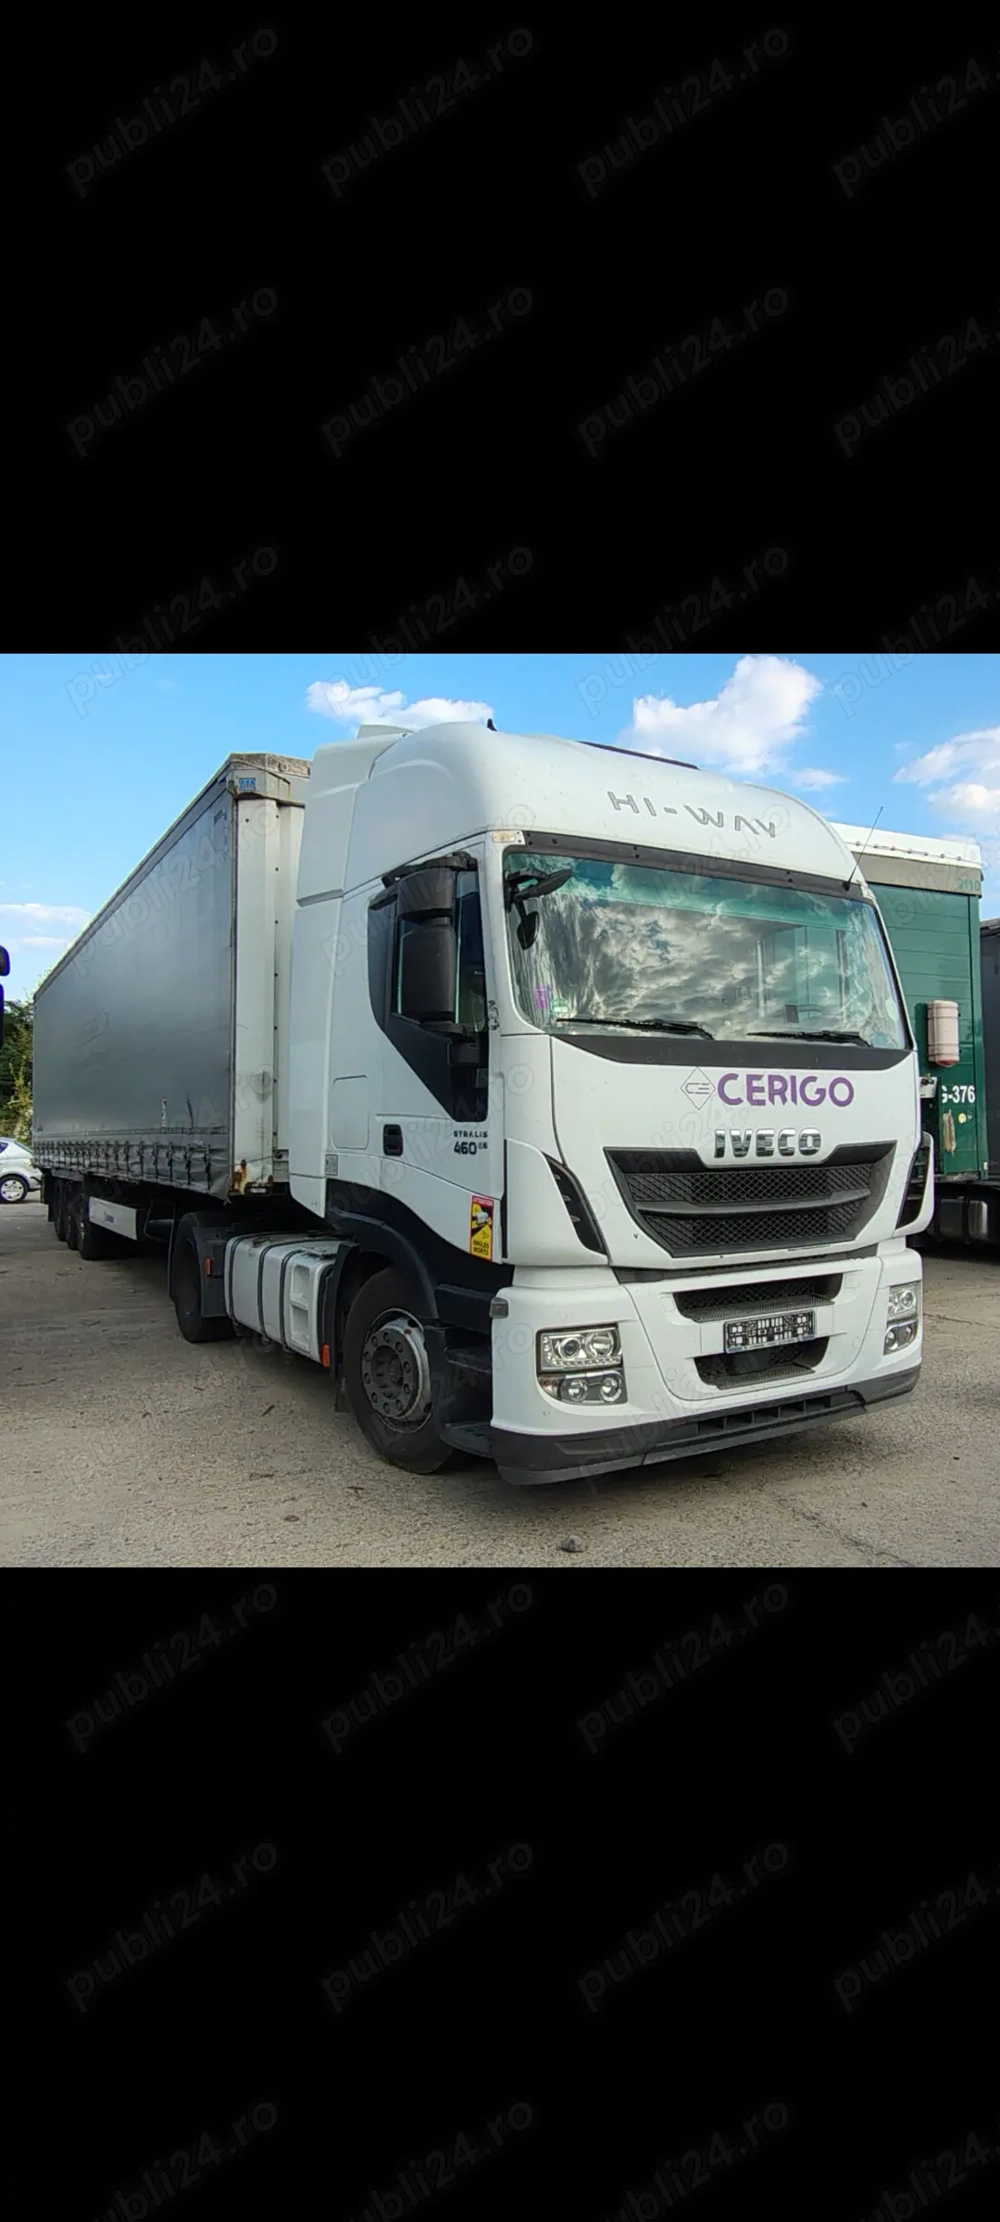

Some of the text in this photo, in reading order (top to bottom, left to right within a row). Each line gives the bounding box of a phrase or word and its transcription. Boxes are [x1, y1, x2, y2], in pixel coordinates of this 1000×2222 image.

[607, 791, 776, 838] HI-WAY
[717, 1073, 854, 1107] CERIGO
[453, 1130, 488, 1138] STRALIS
[453, 1141, 477, 1155] 460
[714, 1128, 822, 1158] IVECO
